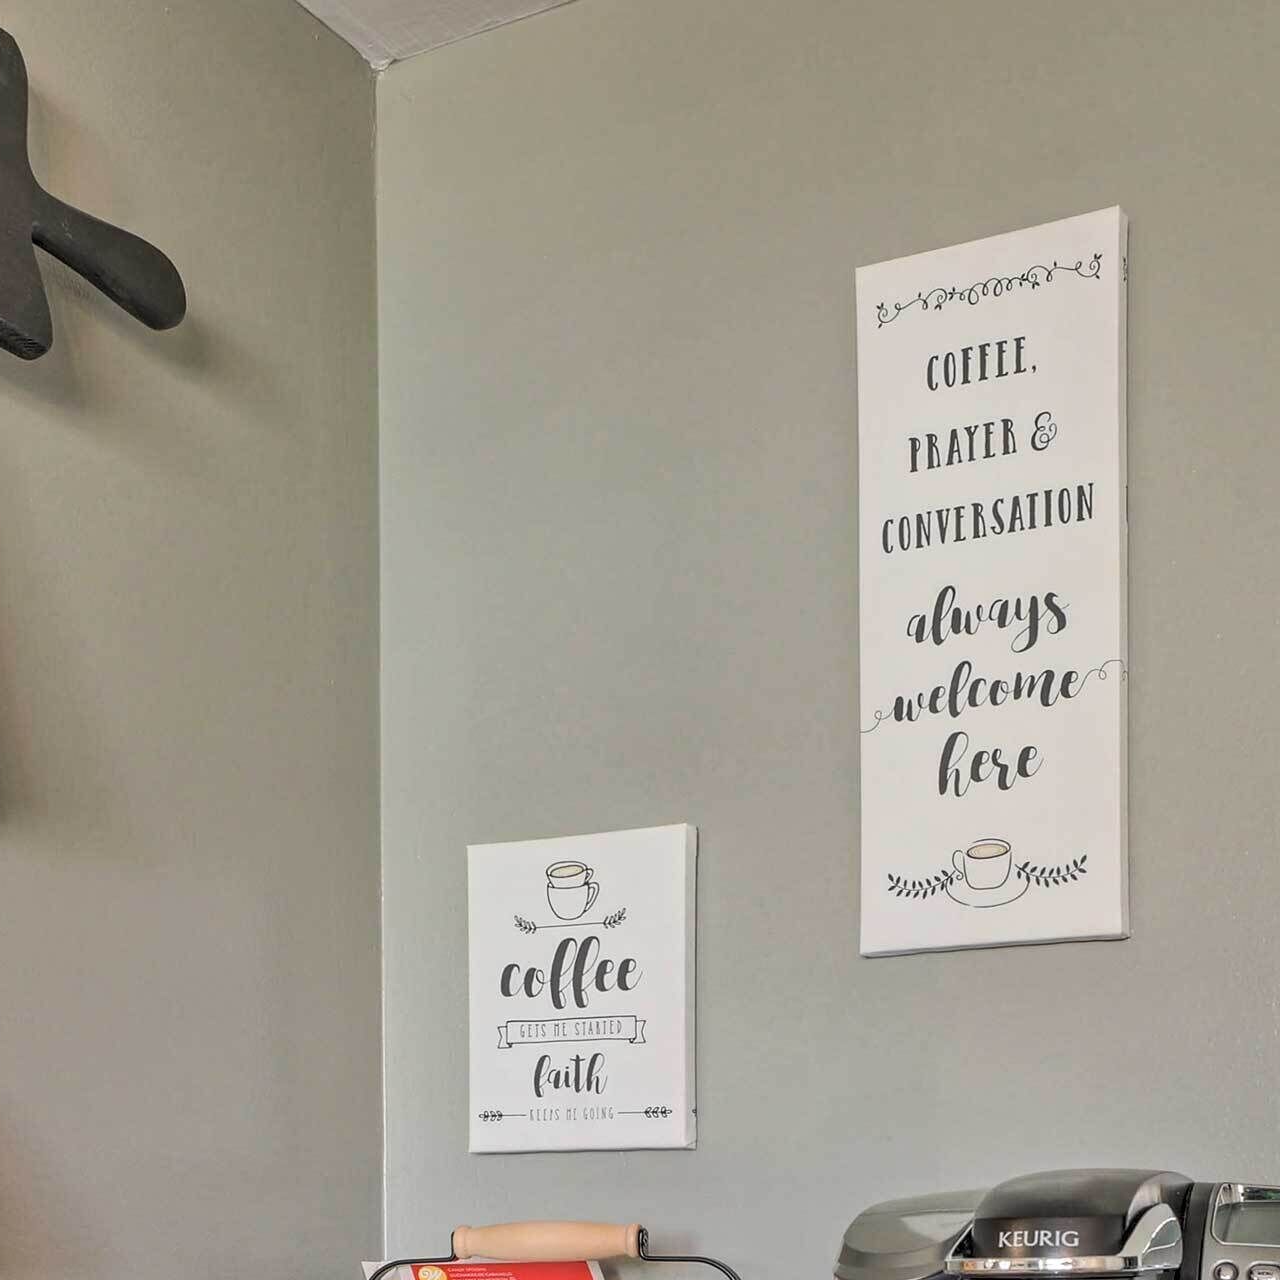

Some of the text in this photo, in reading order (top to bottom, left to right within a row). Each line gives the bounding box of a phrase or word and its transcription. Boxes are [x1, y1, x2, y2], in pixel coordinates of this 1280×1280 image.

[926, 336, 1037, 391] COFFEE,
[908, 411, 1057, 473] PRAYER &
[881, 483, 1095, 554] CONVERSATION
[906, 585, 1070, 653] always
[890, 660, 1087, 722] welcome
[938, 731, 1044, 798] here
[500, 935, 643, 1010] coffee
[520, 1020, 622, 1038] GETS ME STARTED
[533, 1052, 608, 1098] faith
[998, 1230, 1080, 1248] KEURIG
